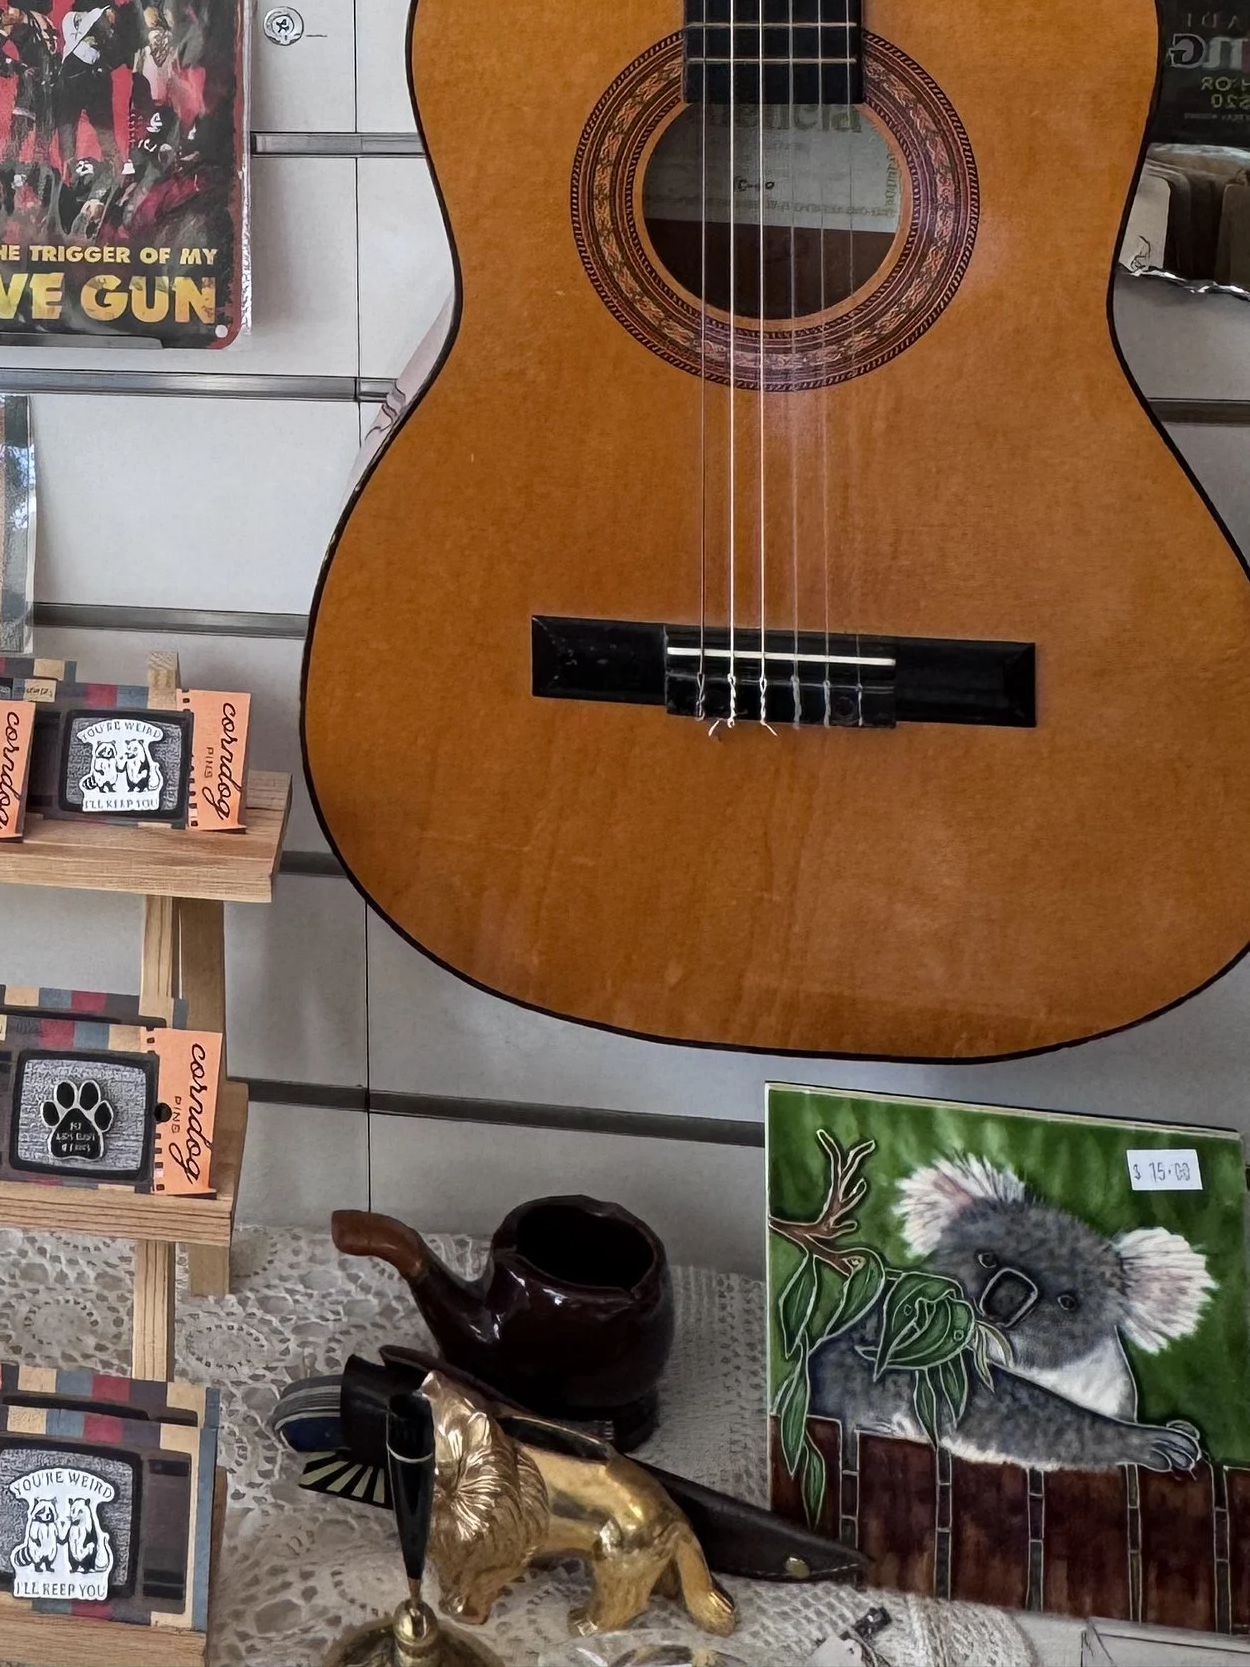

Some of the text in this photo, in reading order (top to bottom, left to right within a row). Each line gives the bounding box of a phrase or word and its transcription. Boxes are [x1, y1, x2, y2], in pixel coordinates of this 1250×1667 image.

[29, 245, 131, 263] TRIGGER
[139, 248, 170, 264] OF
[179, 248, 218, 266] MY
[80, 274, 217, 324] GUN
[202, 702, 242, 820] corndog
[168, 1043, 213, 1185] corndog
[68, 1470, 114, 1500] WEIRD
[42, 1583, 76, 1597] KEEP
[78, 1583, 107, 1598] YOU
